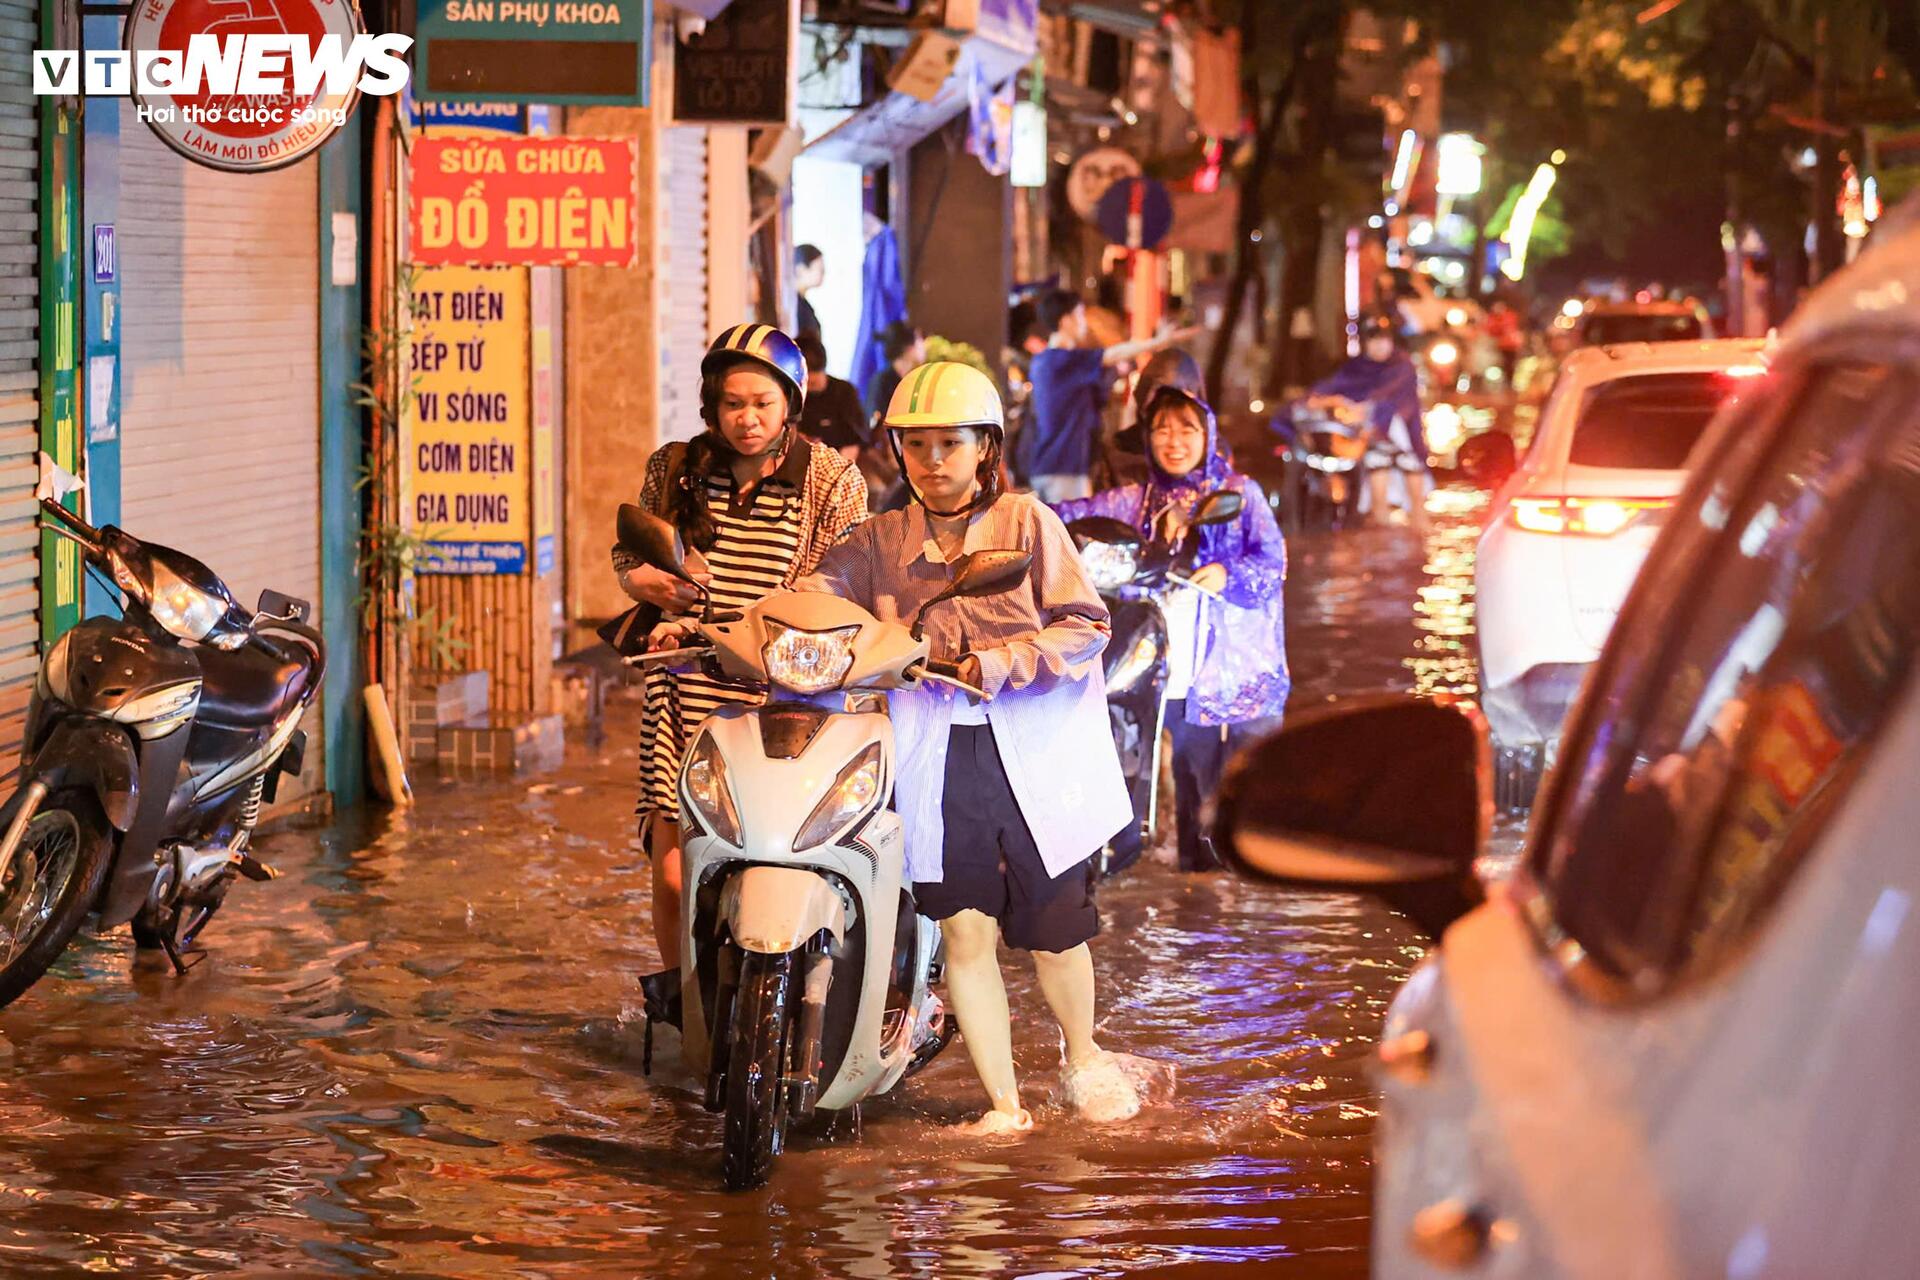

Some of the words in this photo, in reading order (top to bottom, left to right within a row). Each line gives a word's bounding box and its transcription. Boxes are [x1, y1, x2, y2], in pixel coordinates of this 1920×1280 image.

[500, 3, 548, 27] PHỤ
[555, 4, 620, 24] KHOA
[183, 130, 218, 155] LÀM
[222, 144, 252, 160] MỚI
[440, 141, 507, 174] SỬA
[516, 144, 605, 174] CHỮA
[420, 178, 489, 249] ĐỒ
[504, 186, 627, 260] ĐIỆN
[97, 233, 113, 274] 201
[452, 284, 503, 329] ĐIỆN
[418, 392, 437, 422] VI
[446, 386, 507, 422] SÓNG
[418, 441, 461, 472] CƠM
[468, 437, 514, 480] ĐIỆN
[416, 494, 448, 523] GIA
[455, 494, 508, 531] DỤNG
[111, 636, 145, 654] HONDA
